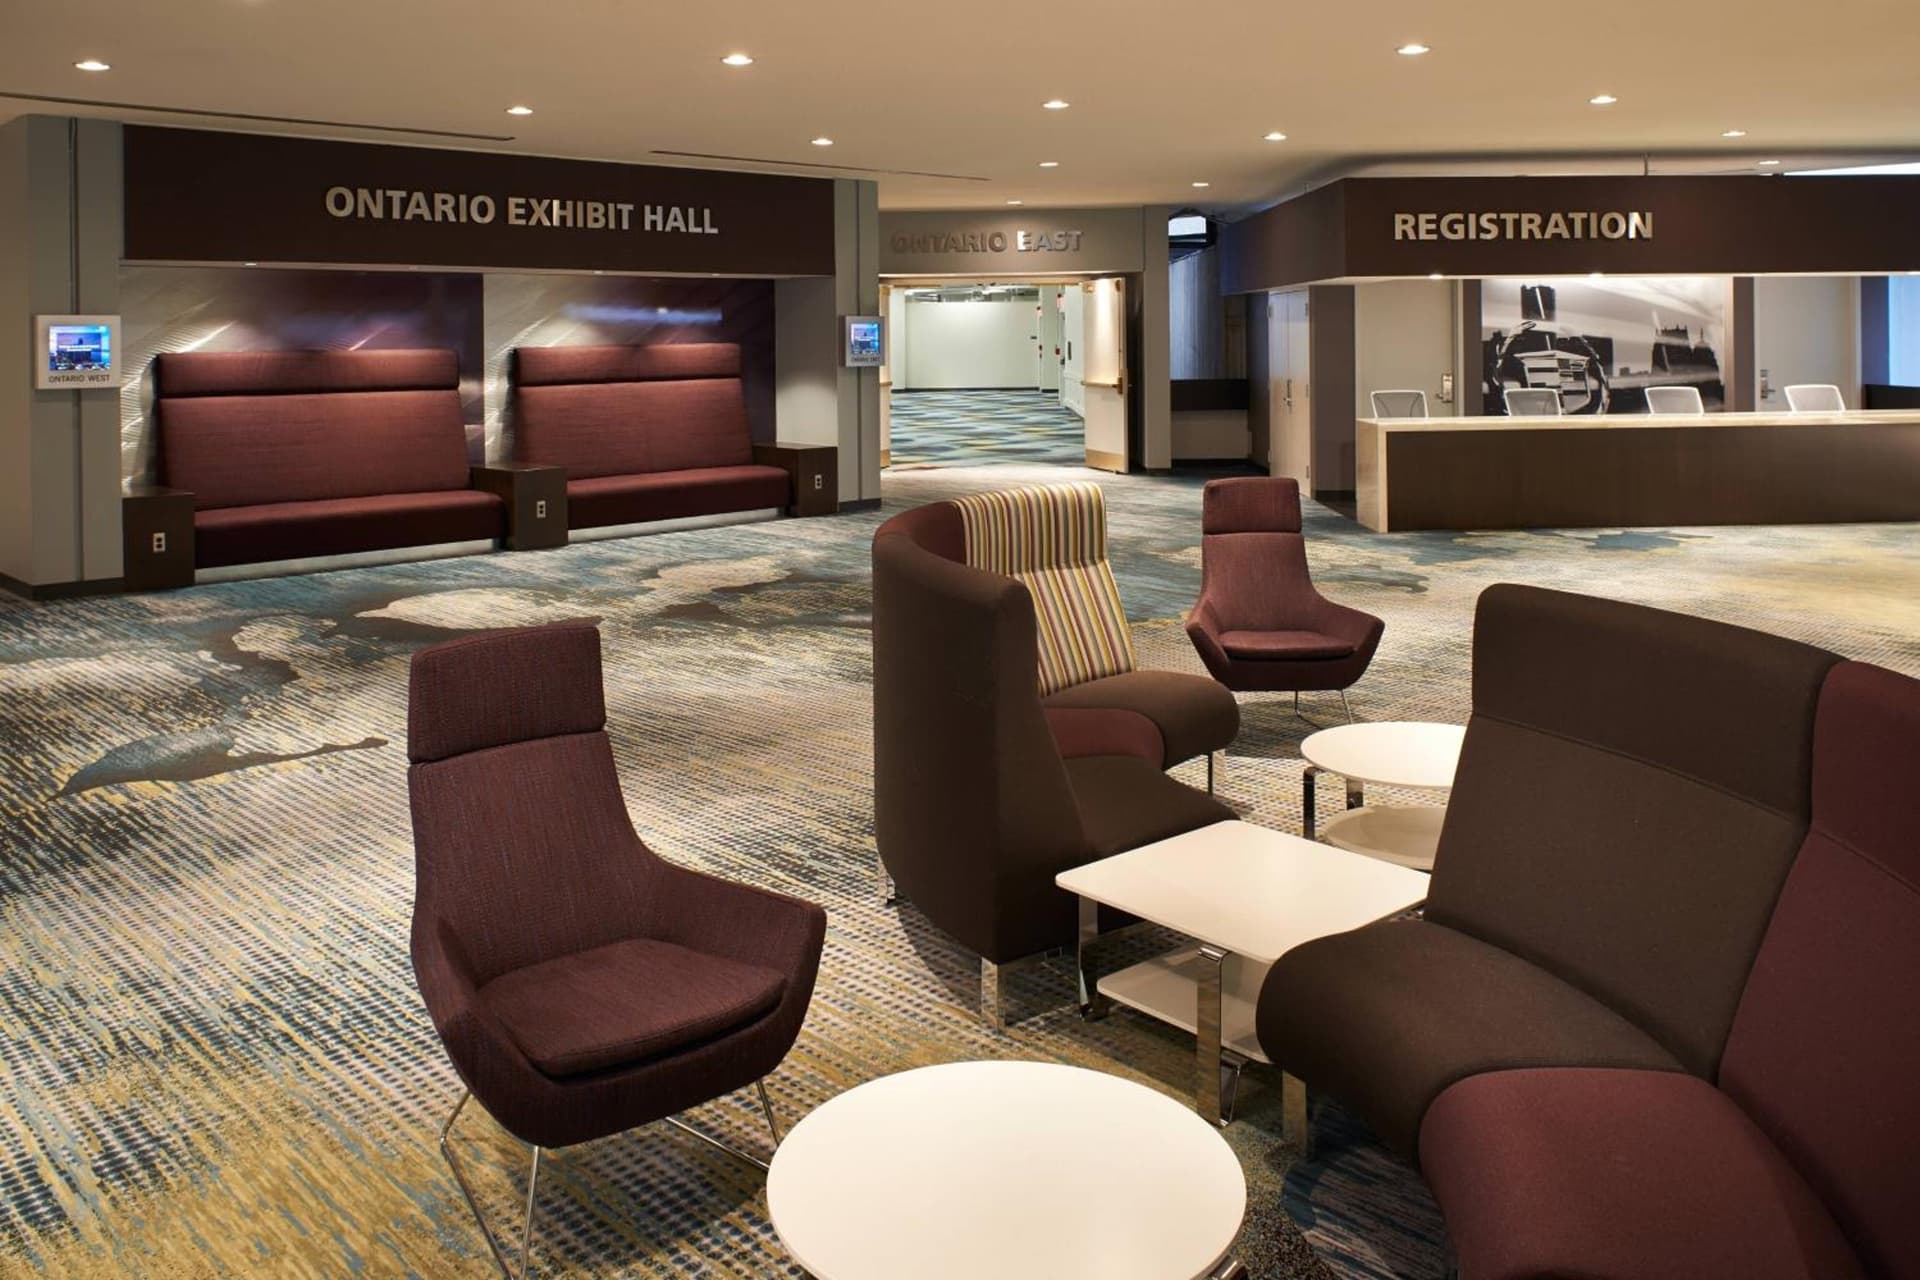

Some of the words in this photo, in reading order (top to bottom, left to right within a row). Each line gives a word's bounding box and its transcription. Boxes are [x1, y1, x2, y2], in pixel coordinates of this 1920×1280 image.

[325, 186, 496, 225] ONTARIO
[508, 197, 635, 230] EXHIBIT
[644, 205, 719, 235] HALL
[1394, 212, 1654, 241] REGISTRATION
[891, 231, 1009, 254] ONTARIO
[1016, 230, 1084, 252] EAST
[48, 375, 86, 383] ONTARIO
[87, 374, 110, 383] WEST
